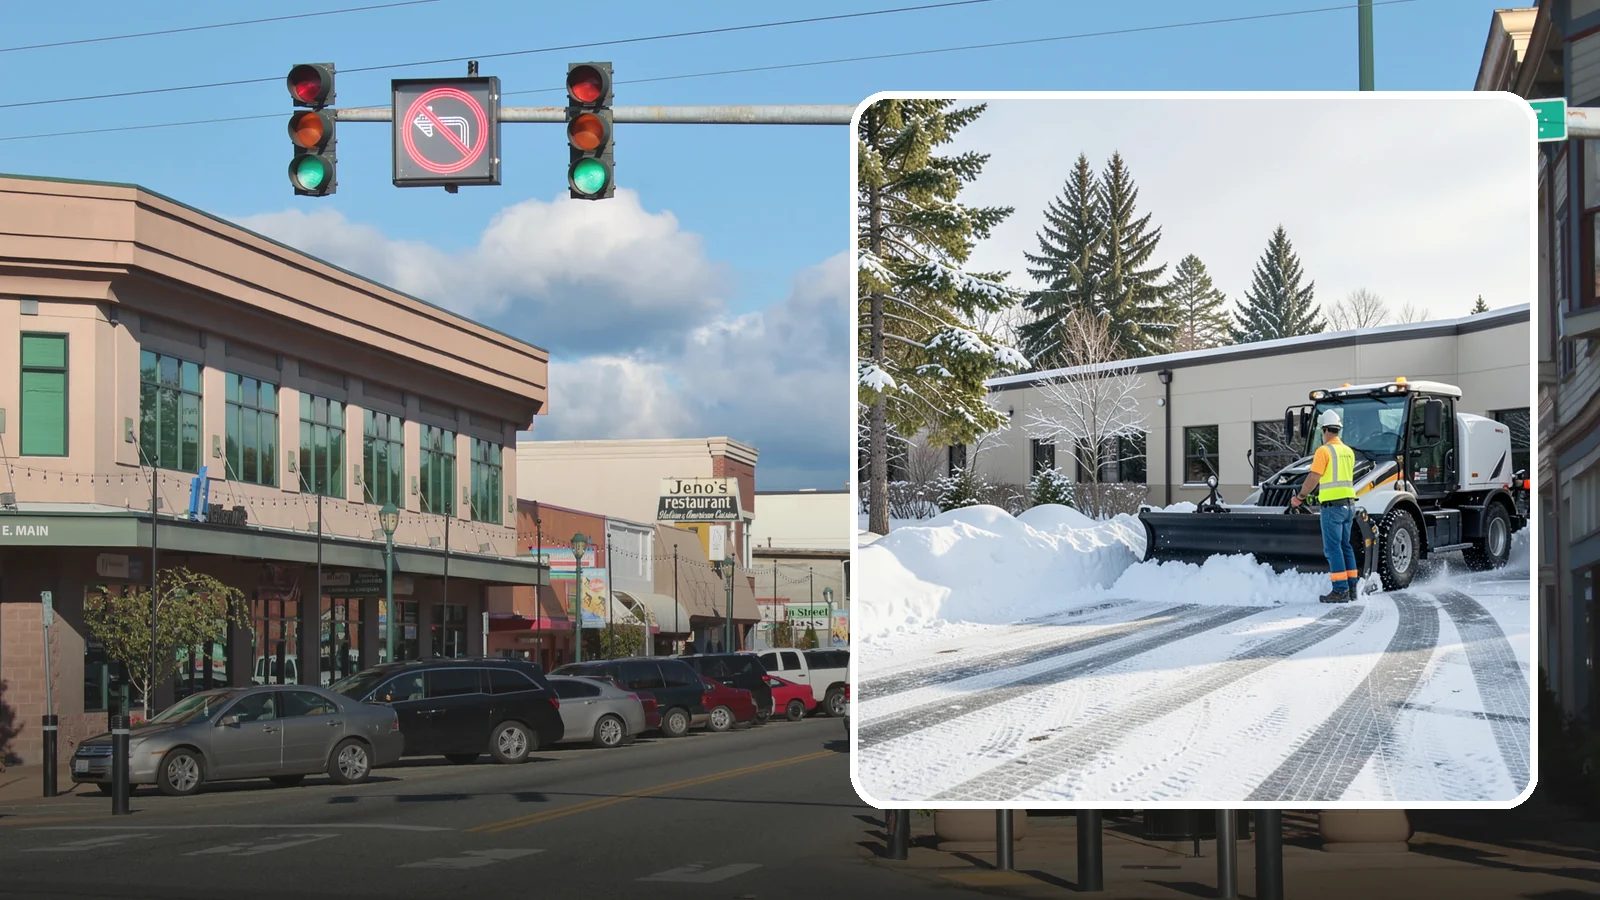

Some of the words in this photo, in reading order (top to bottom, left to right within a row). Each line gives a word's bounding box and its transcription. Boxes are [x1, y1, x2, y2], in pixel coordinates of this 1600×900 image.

[670, 480, 728, 495] Jeno's
[665, 496, 731, 509] restaurant
[659, 510, 682, 520] Italian
[686, 510, 715, 519] American
[715, 510, 737, 519] Cuisine
[2, 525, 13, 536] E.
[15, 525, 48, 536] MAIN
[797, 608, 828, 616] Street
